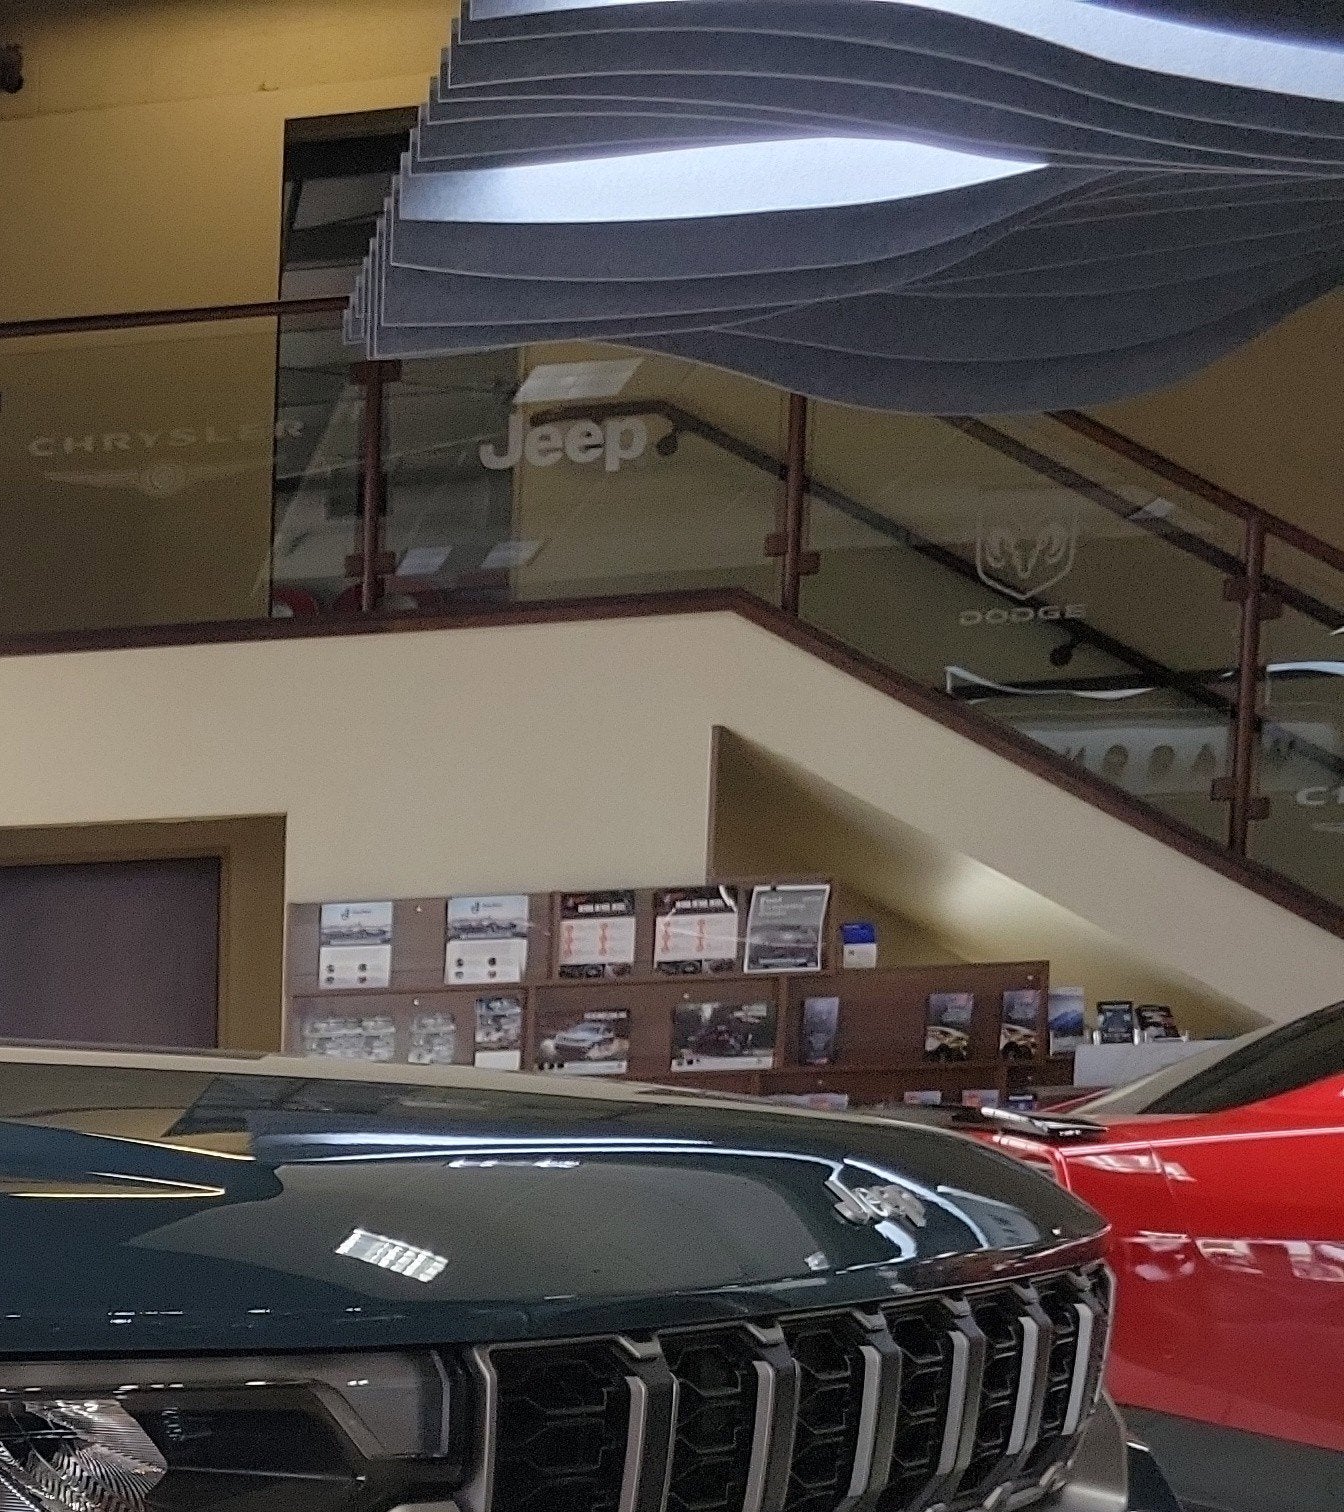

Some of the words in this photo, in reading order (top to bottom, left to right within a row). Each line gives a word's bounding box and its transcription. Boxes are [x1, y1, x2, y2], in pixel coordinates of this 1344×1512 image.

[28, 418, 304, 456] CHRYSLER
[479, 404, 648, 472] Jeep
[958, 603, 1087, 625] DODGE
